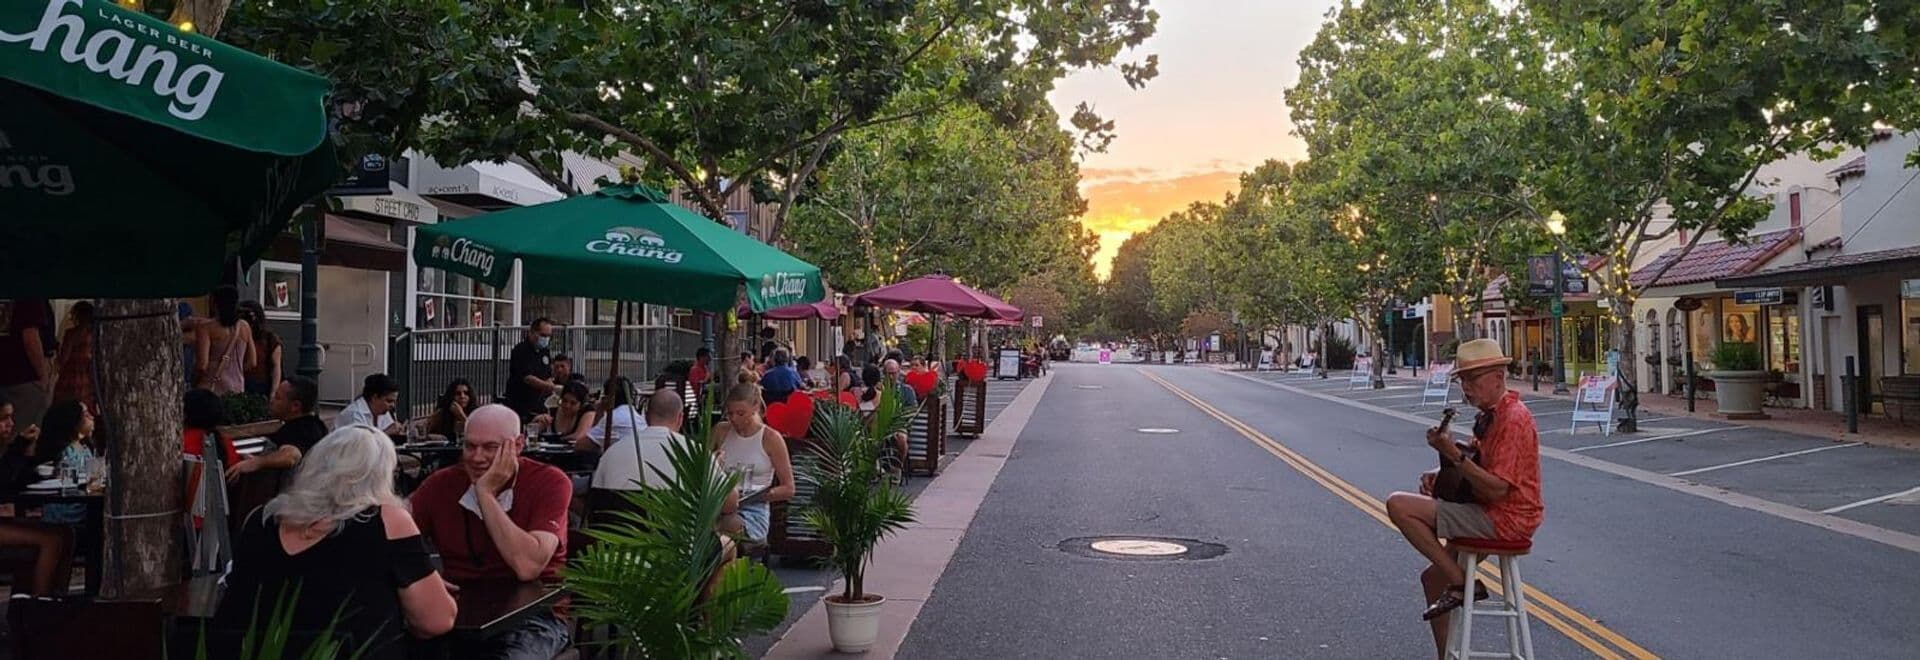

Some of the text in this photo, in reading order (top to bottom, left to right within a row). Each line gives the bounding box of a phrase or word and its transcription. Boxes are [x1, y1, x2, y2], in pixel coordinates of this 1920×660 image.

[99, 8, 213, 59] LAGER BEER
[0, 0, 225, 120] hang
[374, 197, 400, 217] STREET
[451, 237, 495, 277] Chang
[585, 239, 683, 263] Chang
[776, 272, 806, 299] Chang
